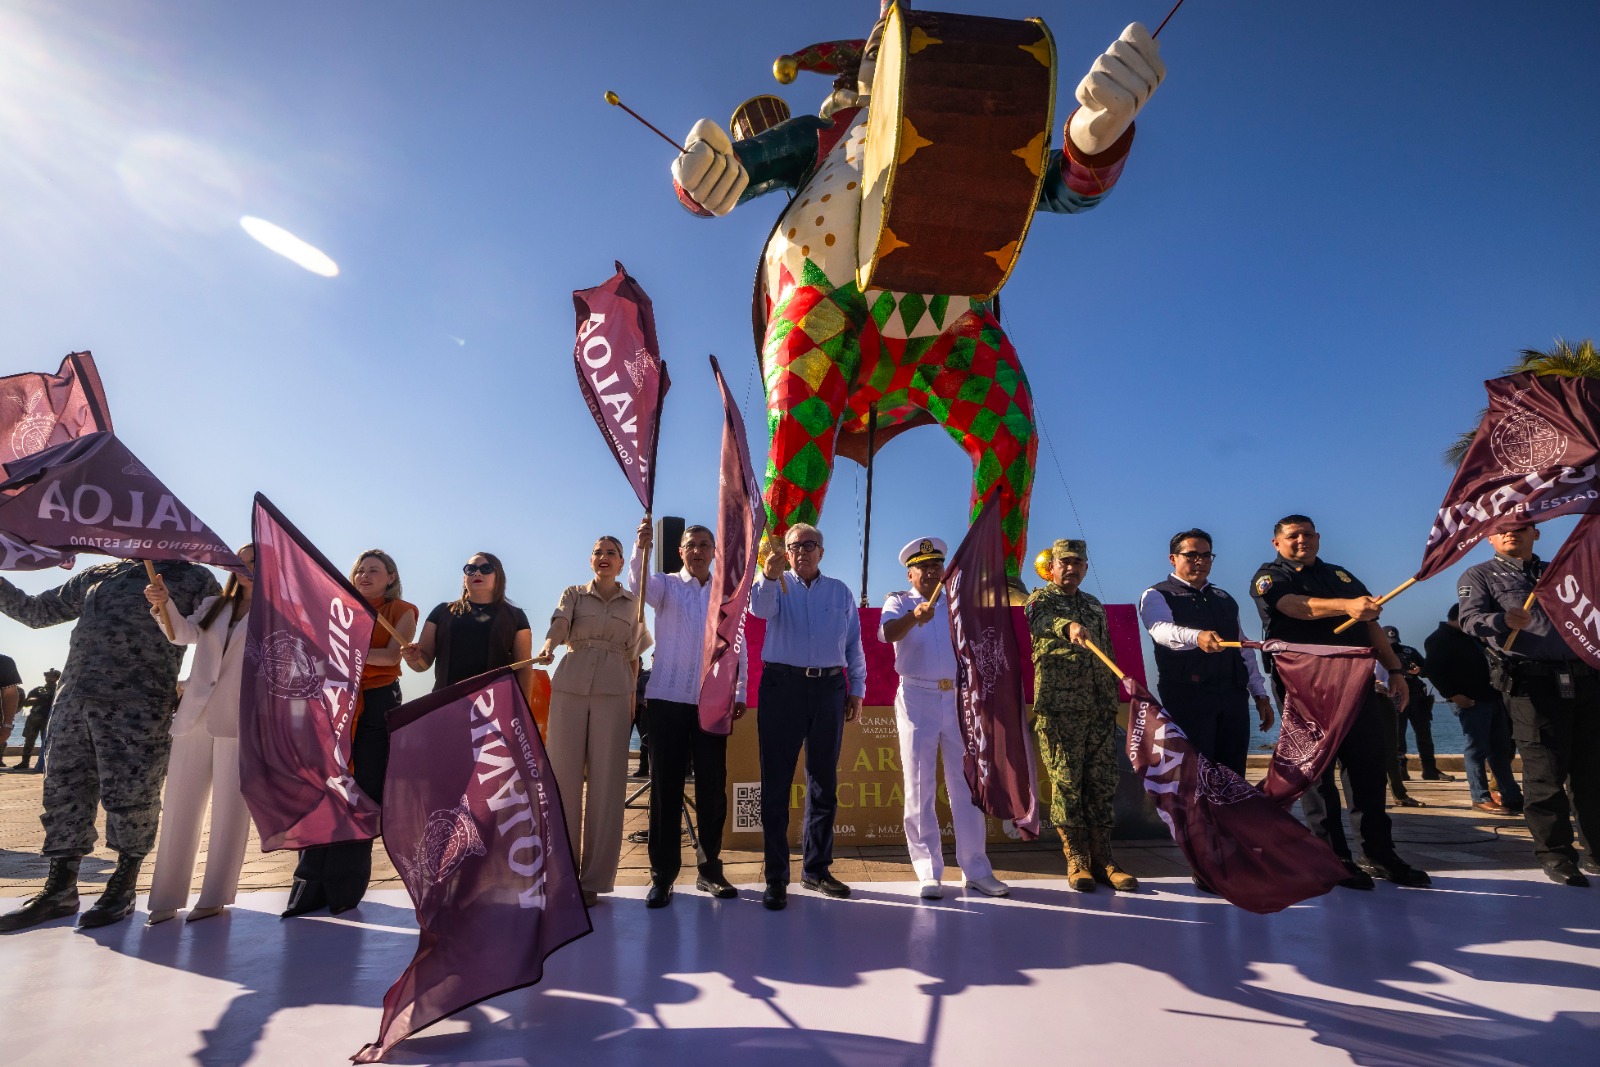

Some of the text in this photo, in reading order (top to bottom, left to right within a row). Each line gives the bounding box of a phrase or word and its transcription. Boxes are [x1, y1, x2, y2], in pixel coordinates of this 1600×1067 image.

[859, 716, 896, 726] CARNA
[1130, 701, 1150, 762] GOBIERNO
[852, 747, 903, 772] AR
